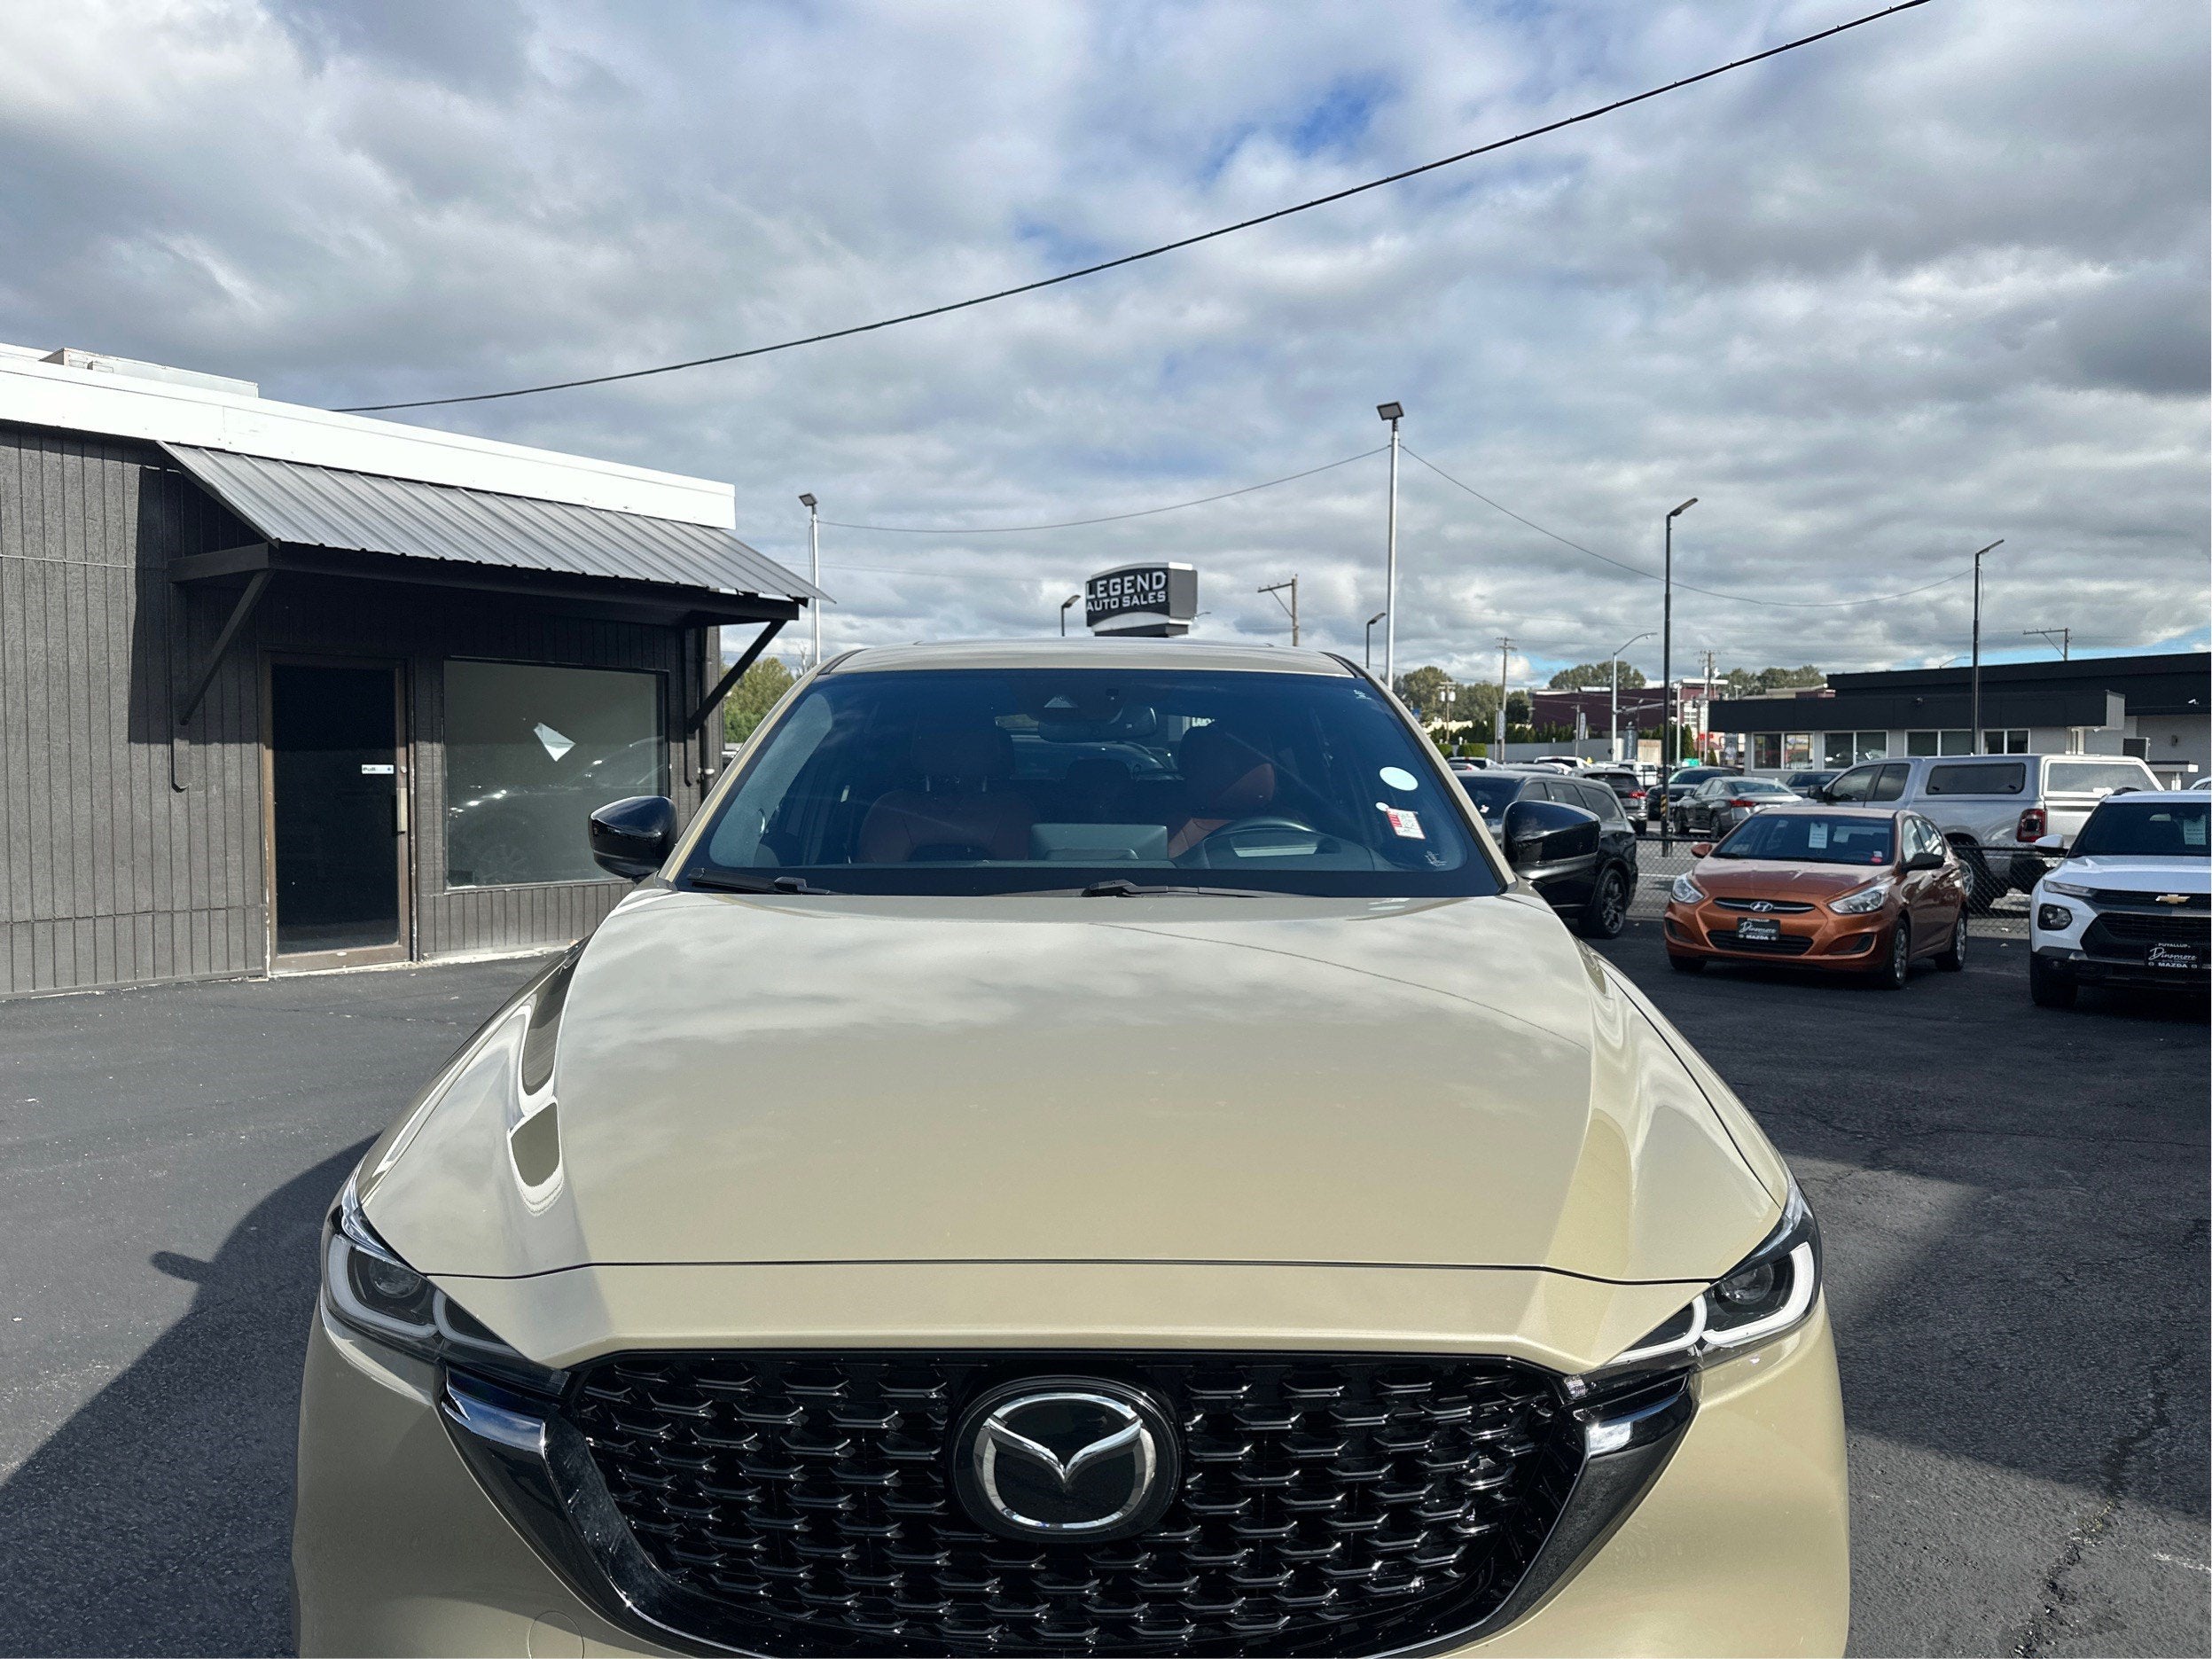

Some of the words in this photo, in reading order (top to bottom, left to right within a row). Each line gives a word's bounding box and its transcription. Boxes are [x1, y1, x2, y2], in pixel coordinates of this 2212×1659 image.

[1086, 571, 1166, 599] LEGEND
[1087, 598, 1119, 612] AUTO
[1122, 591, 1166, 607] SALES
